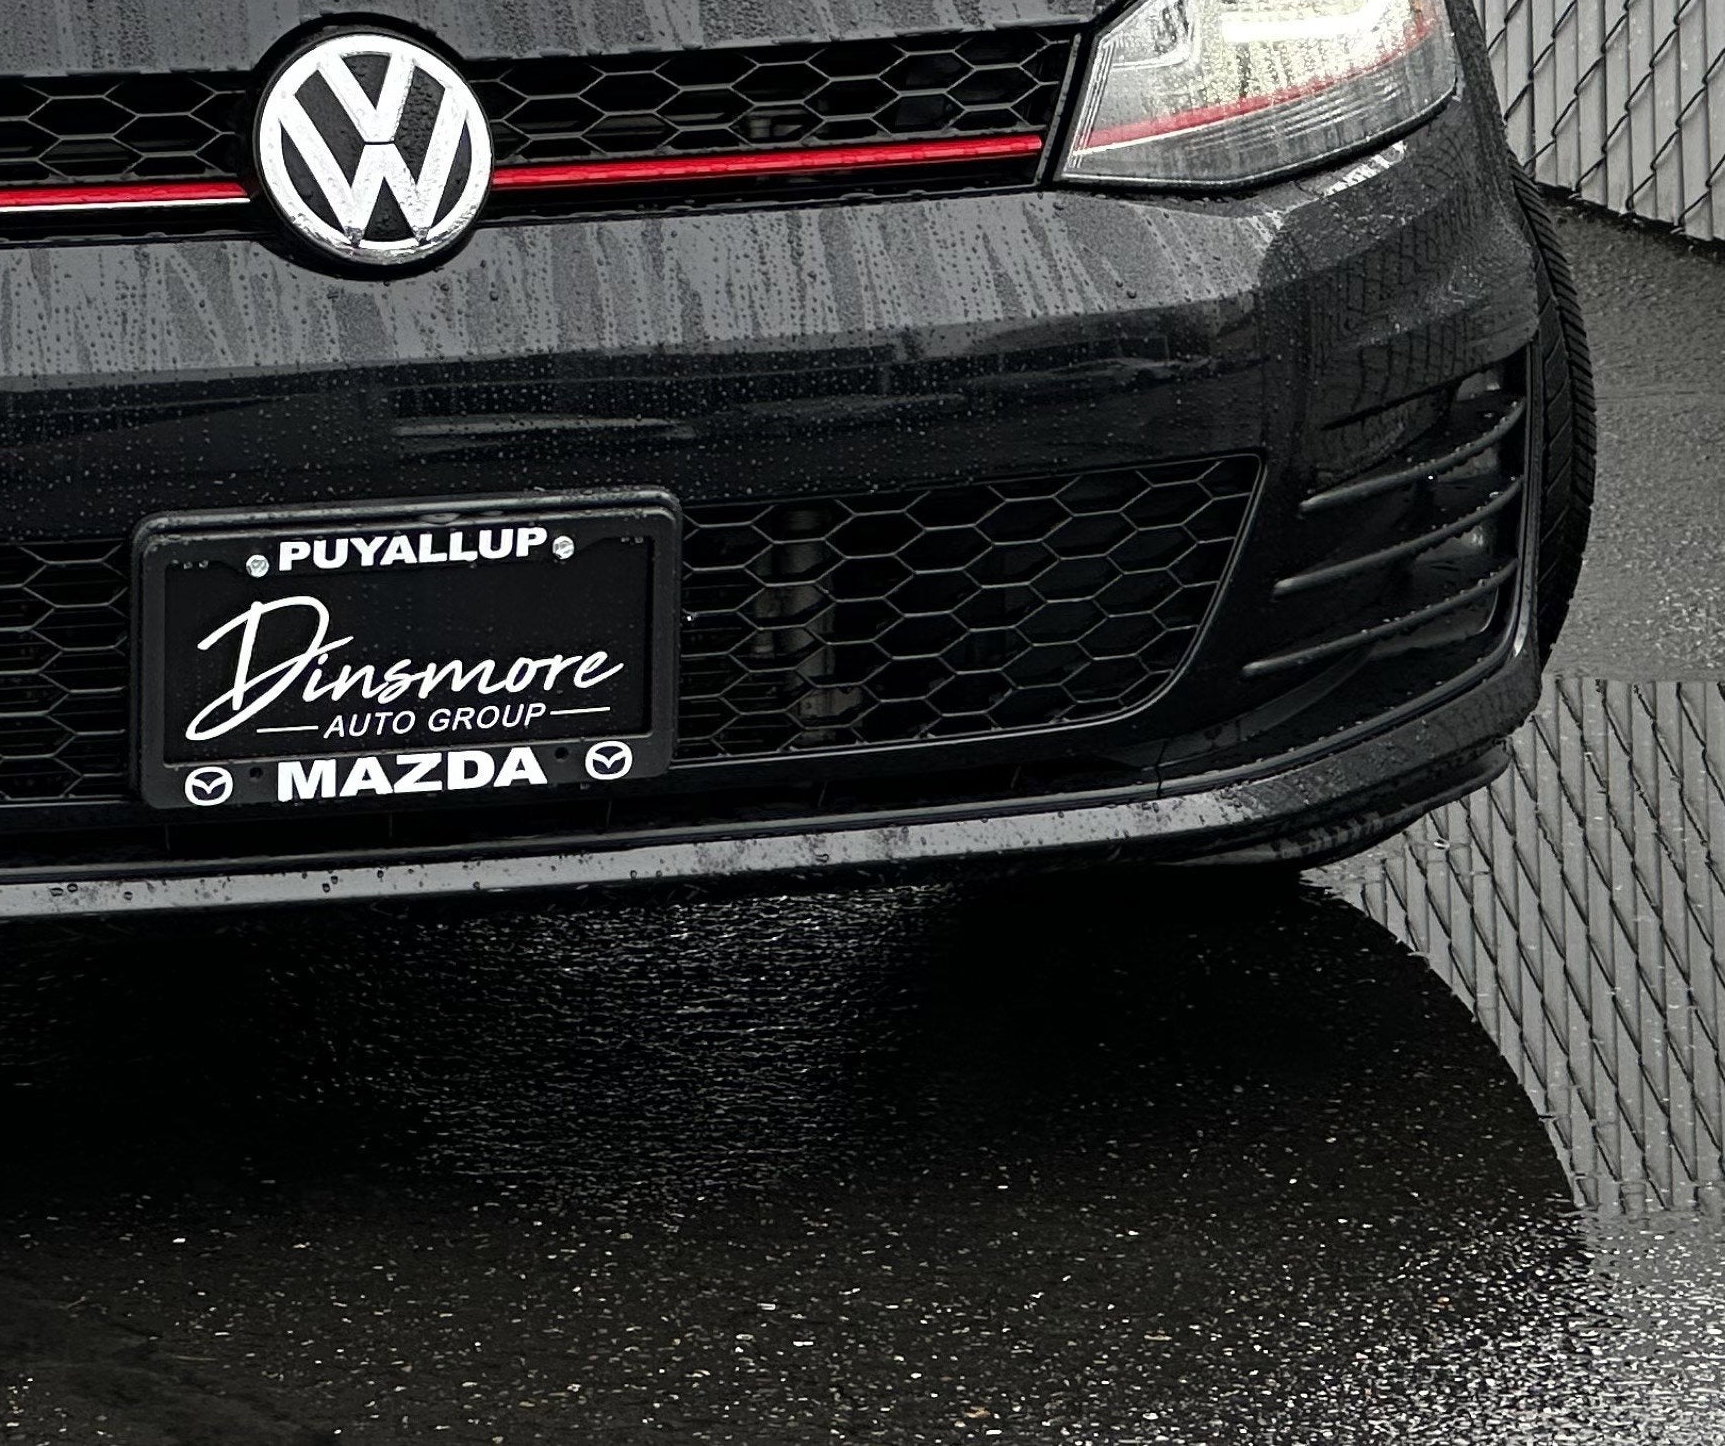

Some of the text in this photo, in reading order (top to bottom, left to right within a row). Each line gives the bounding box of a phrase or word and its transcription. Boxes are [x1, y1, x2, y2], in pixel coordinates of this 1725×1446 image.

[278, 527, 548, 571] PUYALLUP
[185, 595, 625, 741] Dinsmore
[323, 702, 547, 739] AUTO GROUP
[277, 746, 548, 803] MAZDA
